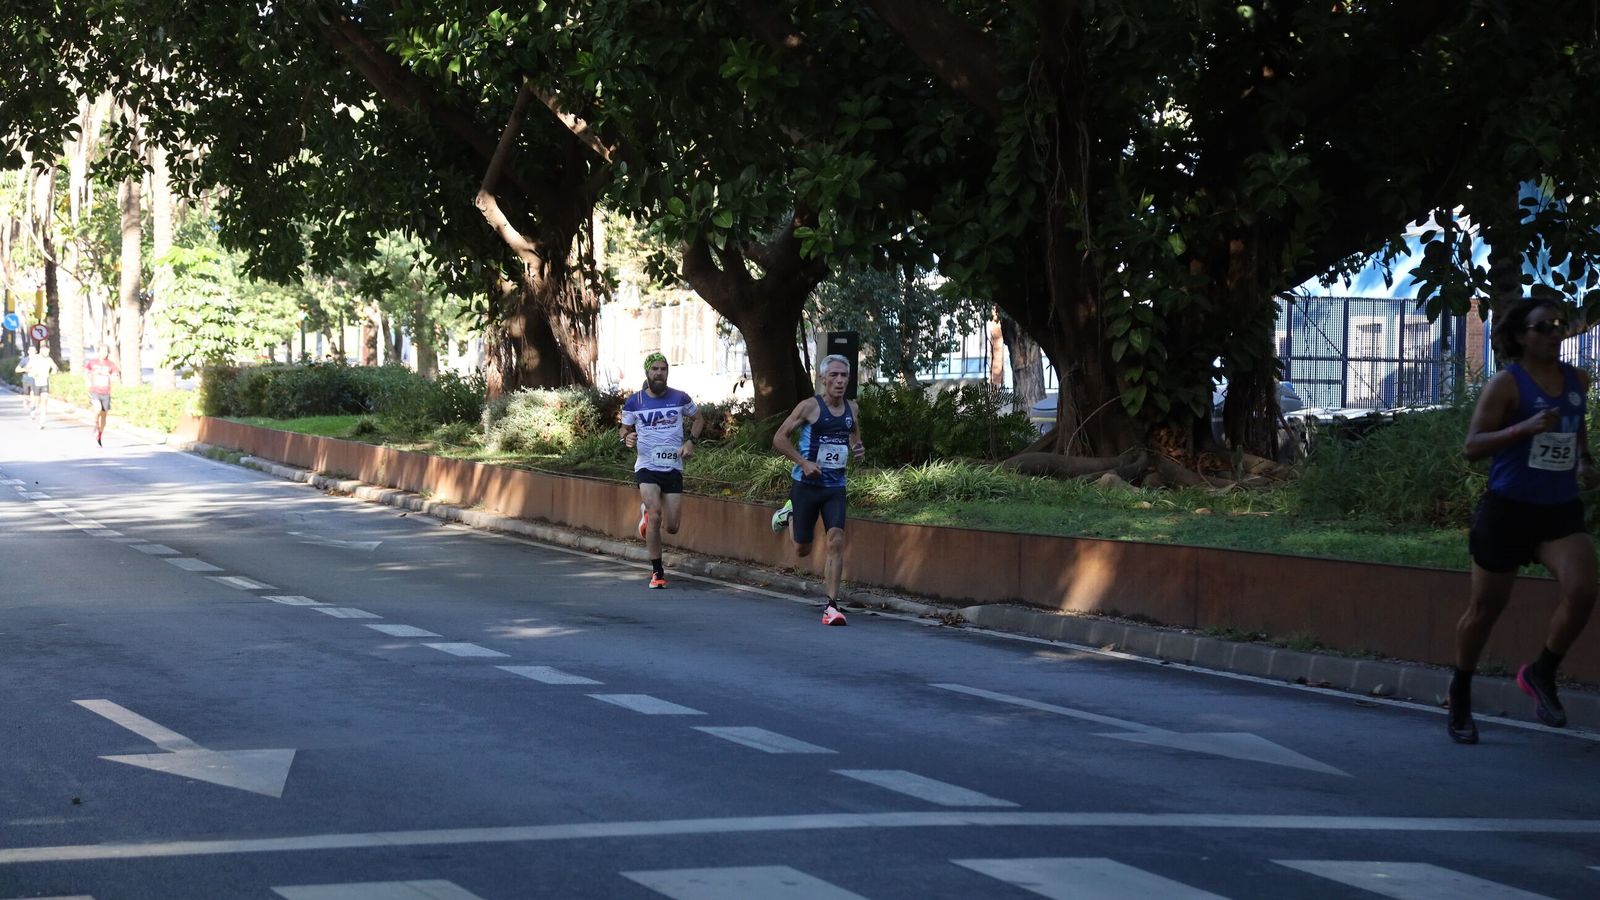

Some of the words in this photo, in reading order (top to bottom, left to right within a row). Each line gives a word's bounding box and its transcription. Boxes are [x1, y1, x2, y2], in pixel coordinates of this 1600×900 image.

[638, 409, 679, 427] VAS
[825, 452, 840, 462] 24
[1539, 444, 1571, 459] 752
